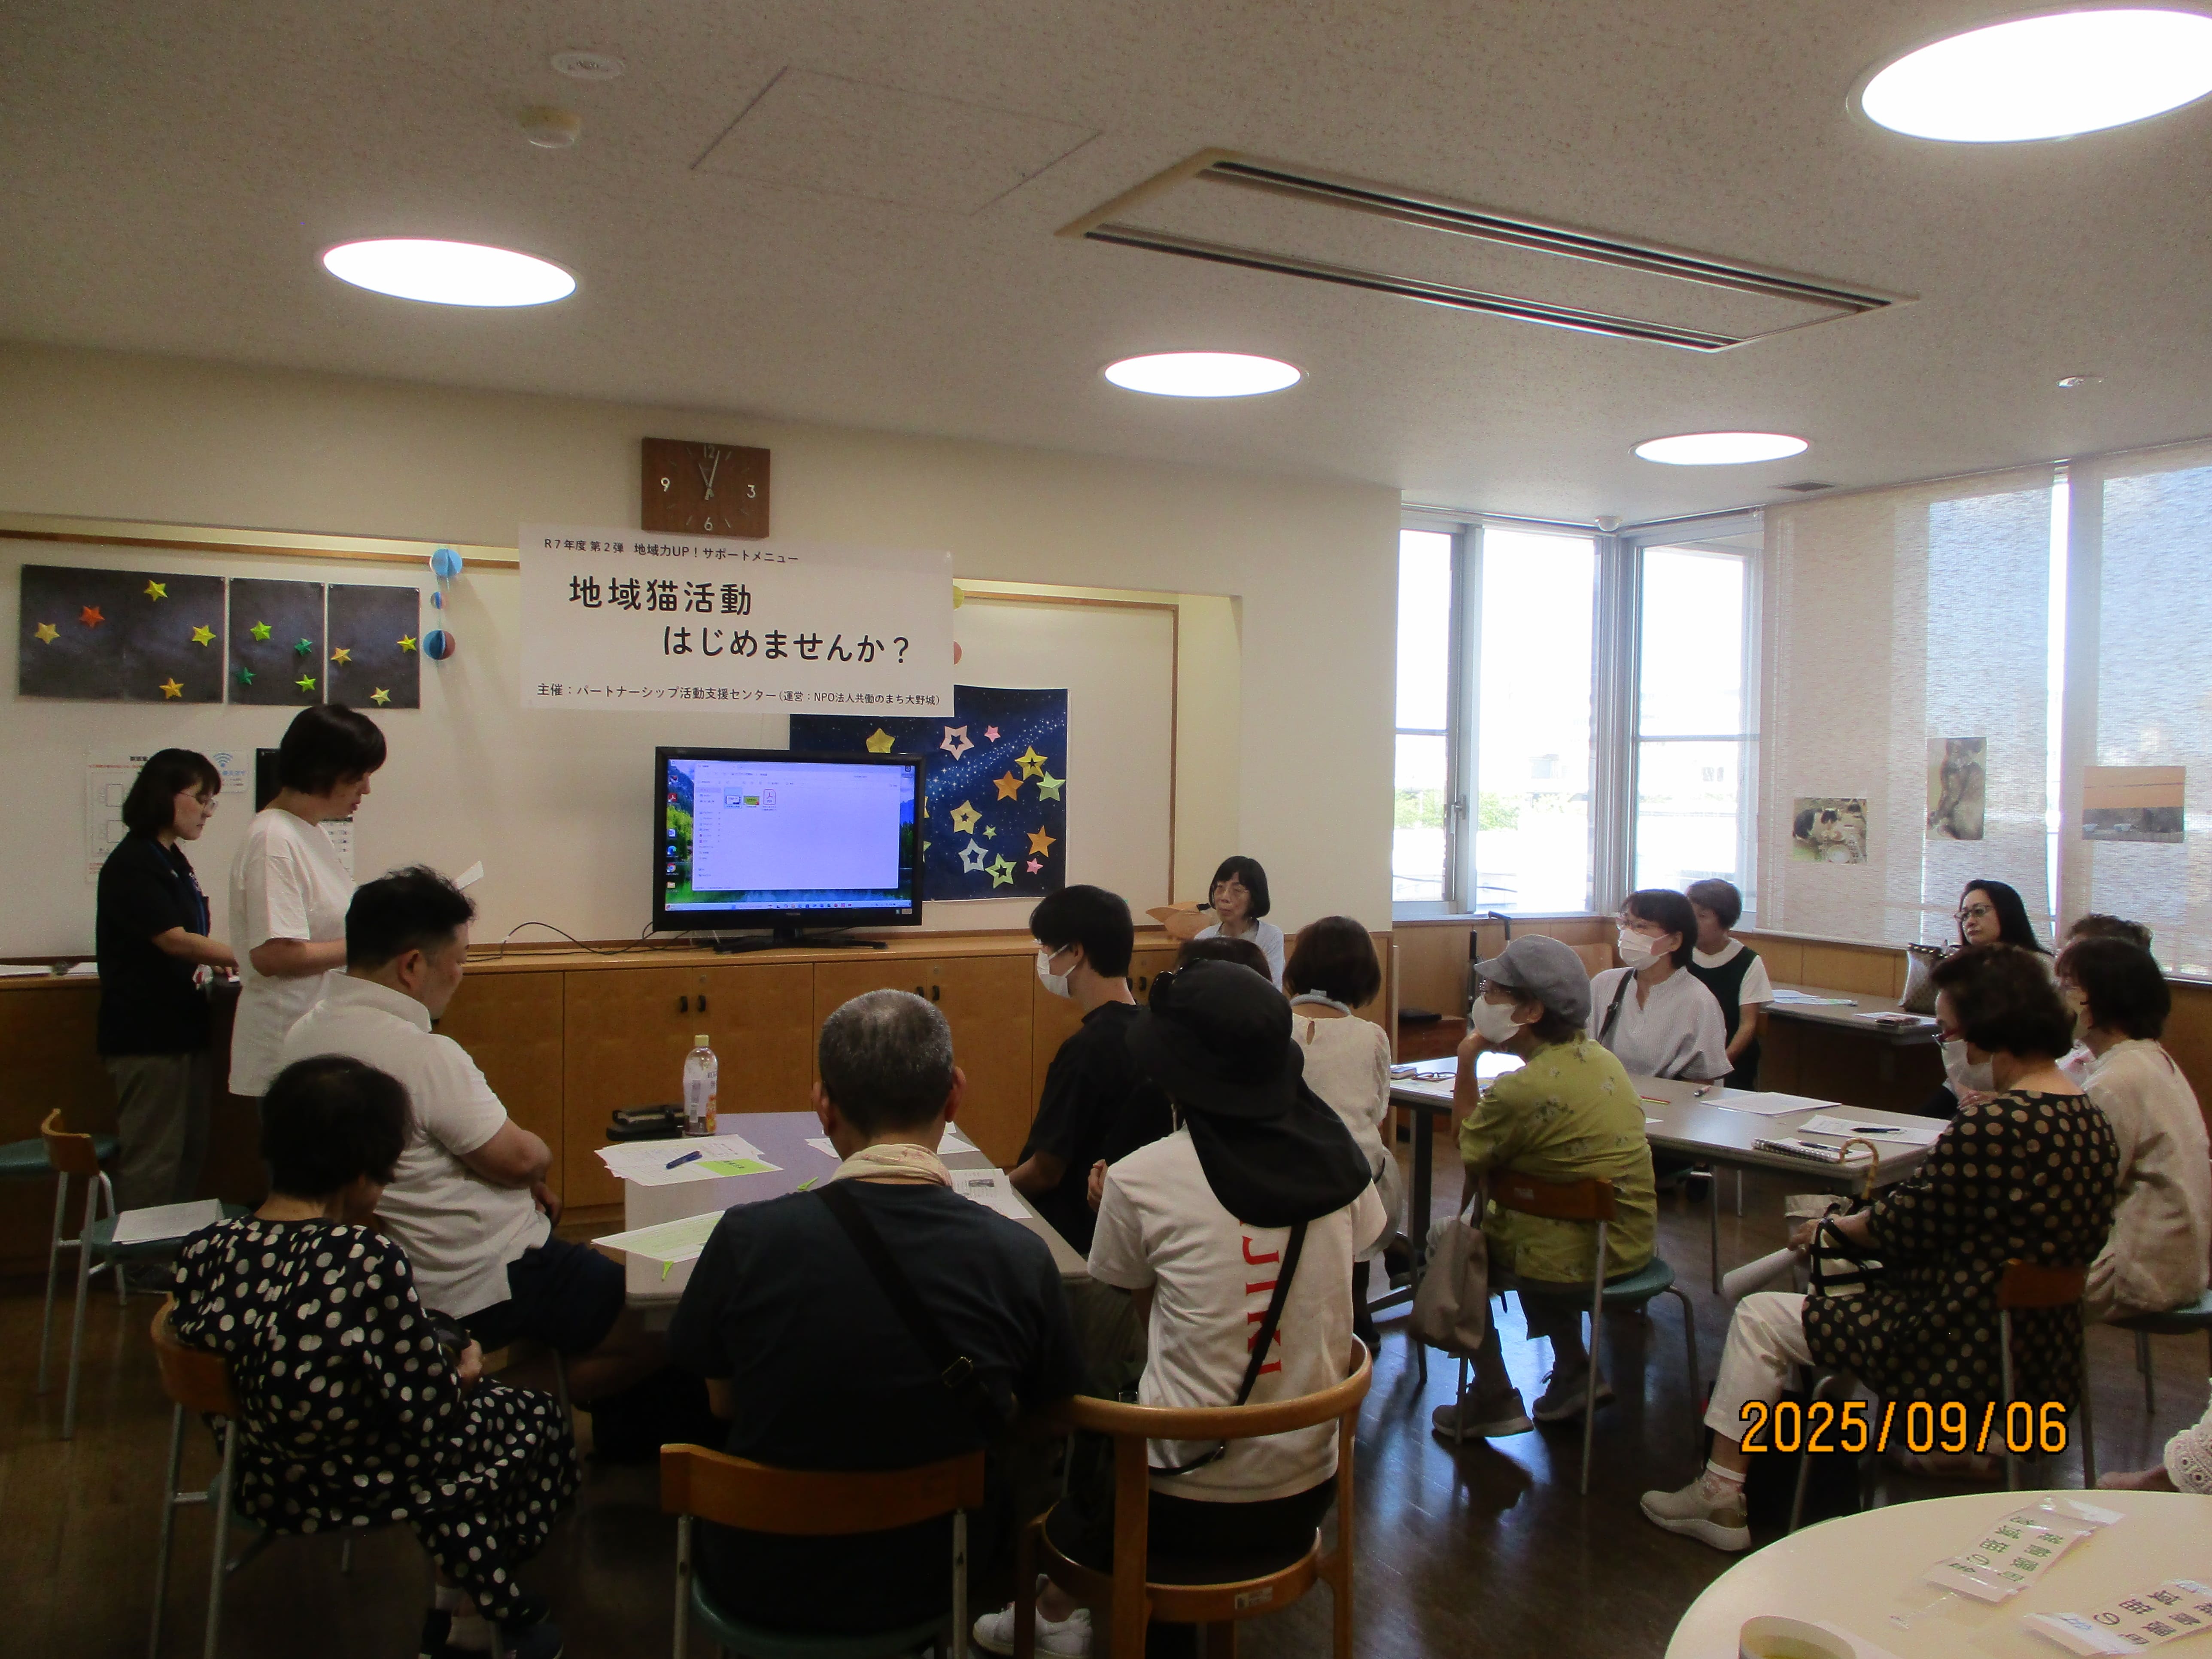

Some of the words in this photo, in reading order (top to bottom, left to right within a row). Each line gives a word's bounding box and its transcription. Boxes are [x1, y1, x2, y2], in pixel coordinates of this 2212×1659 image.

[704, 445, 714, 458] 12
[661, 477, 670, 492] 9
[747, 485, 756, 498] 3
[704, 517, 713, 531] 6
[569, 575, 752, 616] 地域猫活動
[663, 626, 910, 664] はじめませんか？
